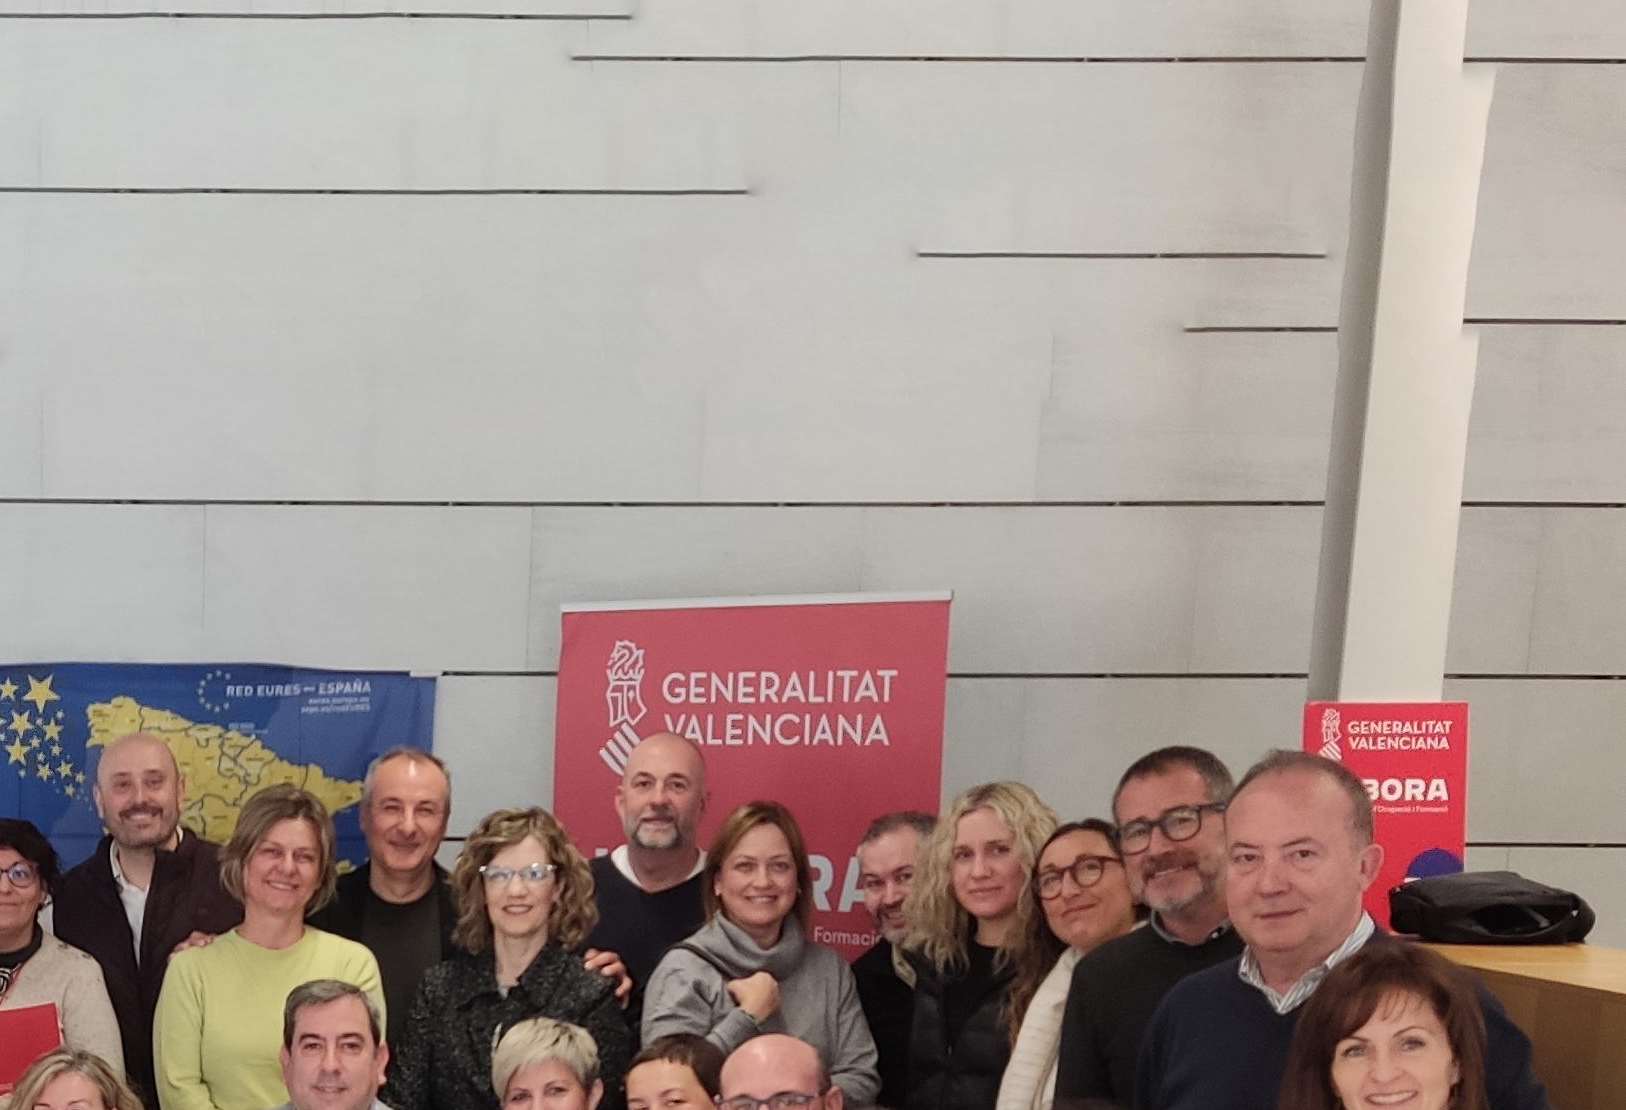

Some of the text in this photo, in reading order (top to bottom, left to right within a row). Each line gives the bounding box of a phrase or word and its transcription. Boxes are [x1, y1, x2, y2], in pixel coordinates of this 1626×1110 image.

[226, 685, 253, 697] RED
[257, 684, 301, 697] EURES
[318, 679, 371, 695] ESPAÑA
[661, 669, 899, 704] GENERALITAT
[664, 712, 891, 746] VALENCIANA
[1347, 720, 1453, 734] GENERALITAT
[1348, 736, 1450, 750] VALENCIANA
